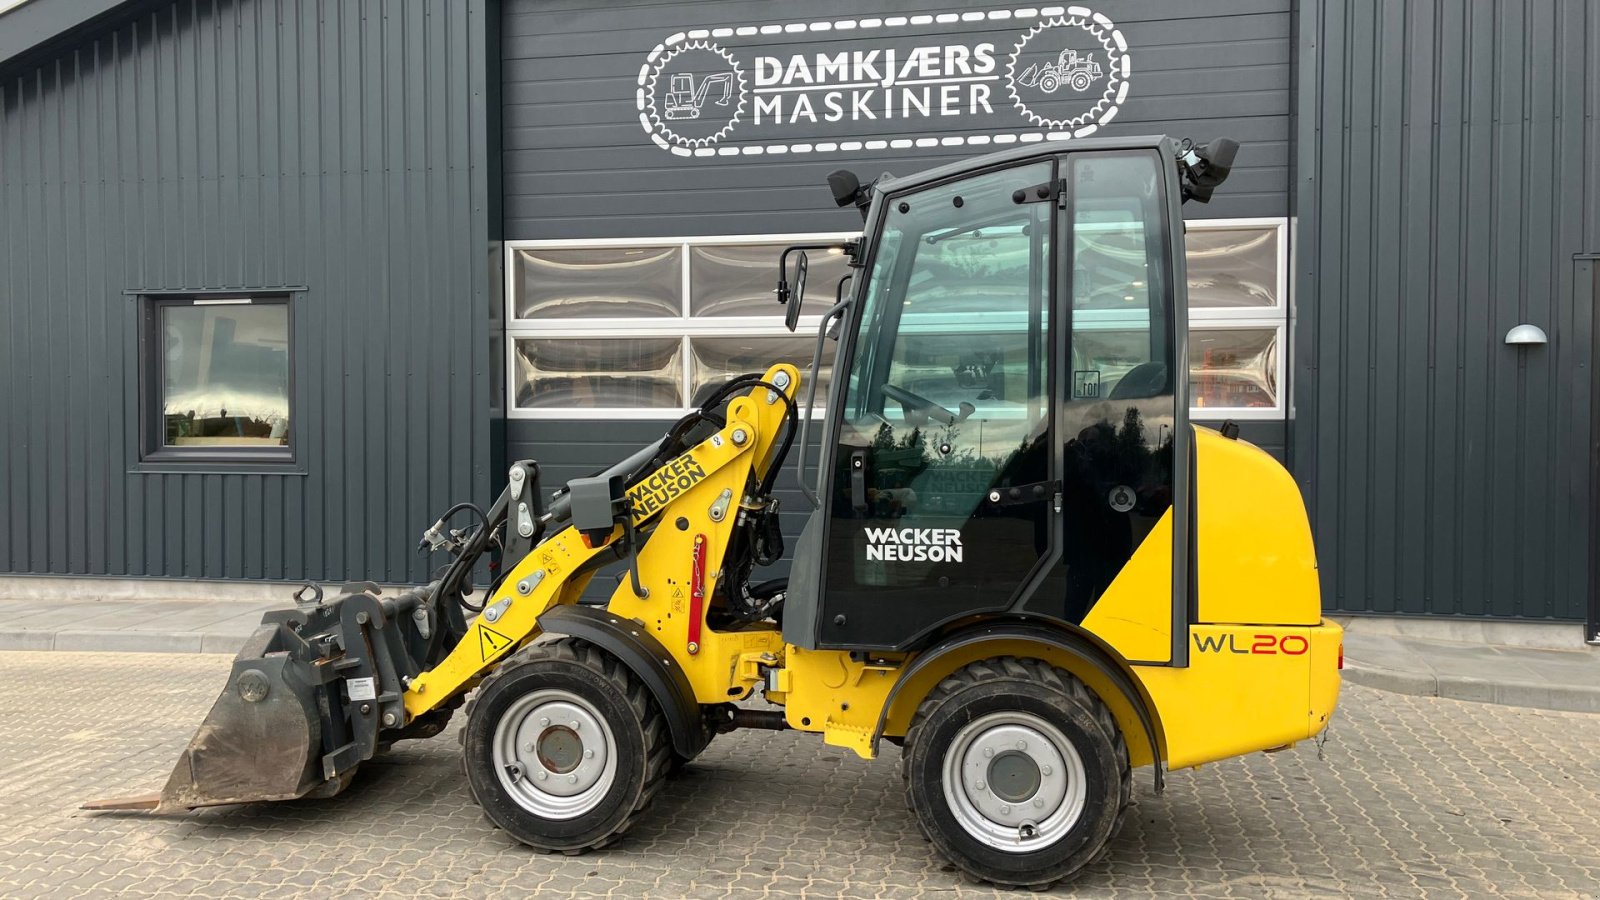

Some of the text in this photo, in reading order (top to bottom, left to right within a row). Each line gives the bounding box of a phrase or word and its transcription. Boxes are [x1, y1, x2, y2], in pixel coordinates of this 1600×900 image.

[754, 42, 996, 88] DAMKJÆRS
[754, 84, 994, 125] MASKINER
[629, 454, 698, 506] WACKER
[631, 464, 707, 522] NEUSON
[864, 527, 962, 546] WACKER
[866, 544, 963, 563] NEUSON
[1192, 632, 1309, 656] WL20
